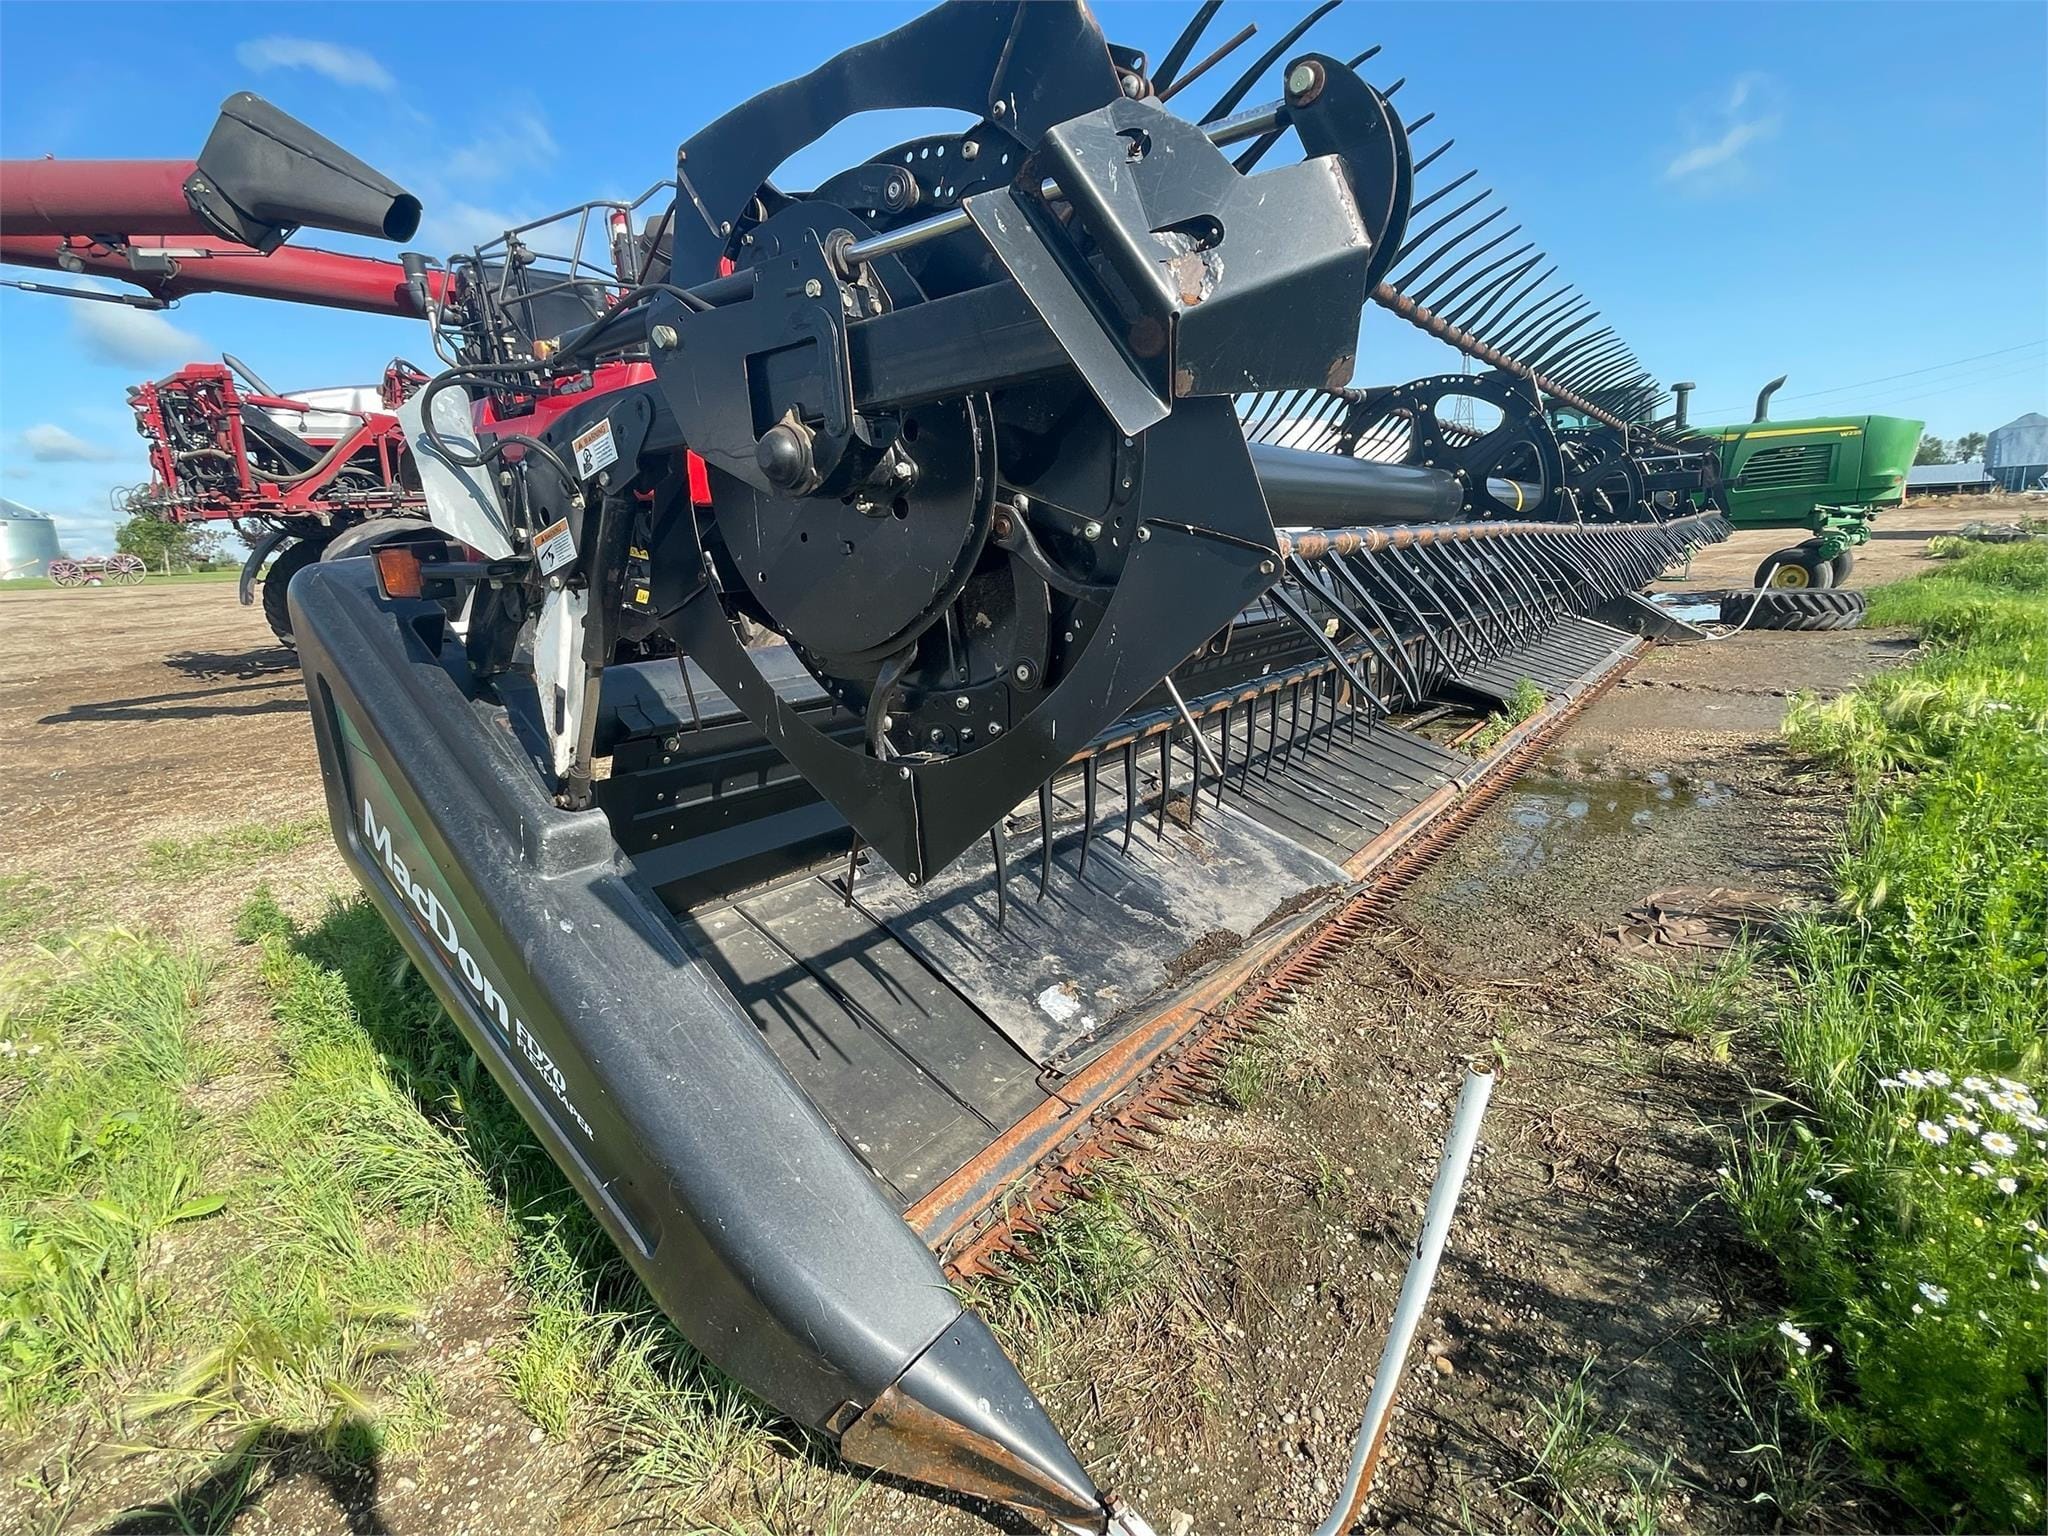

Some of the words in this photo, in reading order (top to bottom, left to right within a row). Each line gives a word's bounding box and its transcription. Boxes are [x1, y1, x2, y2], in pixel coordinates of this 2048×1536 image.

[364, 798, 509, 1032] MacDon
[516, 1018, 567, 1092] FD70
[517, 1035, 594, 1142] FLEXDRAPER
